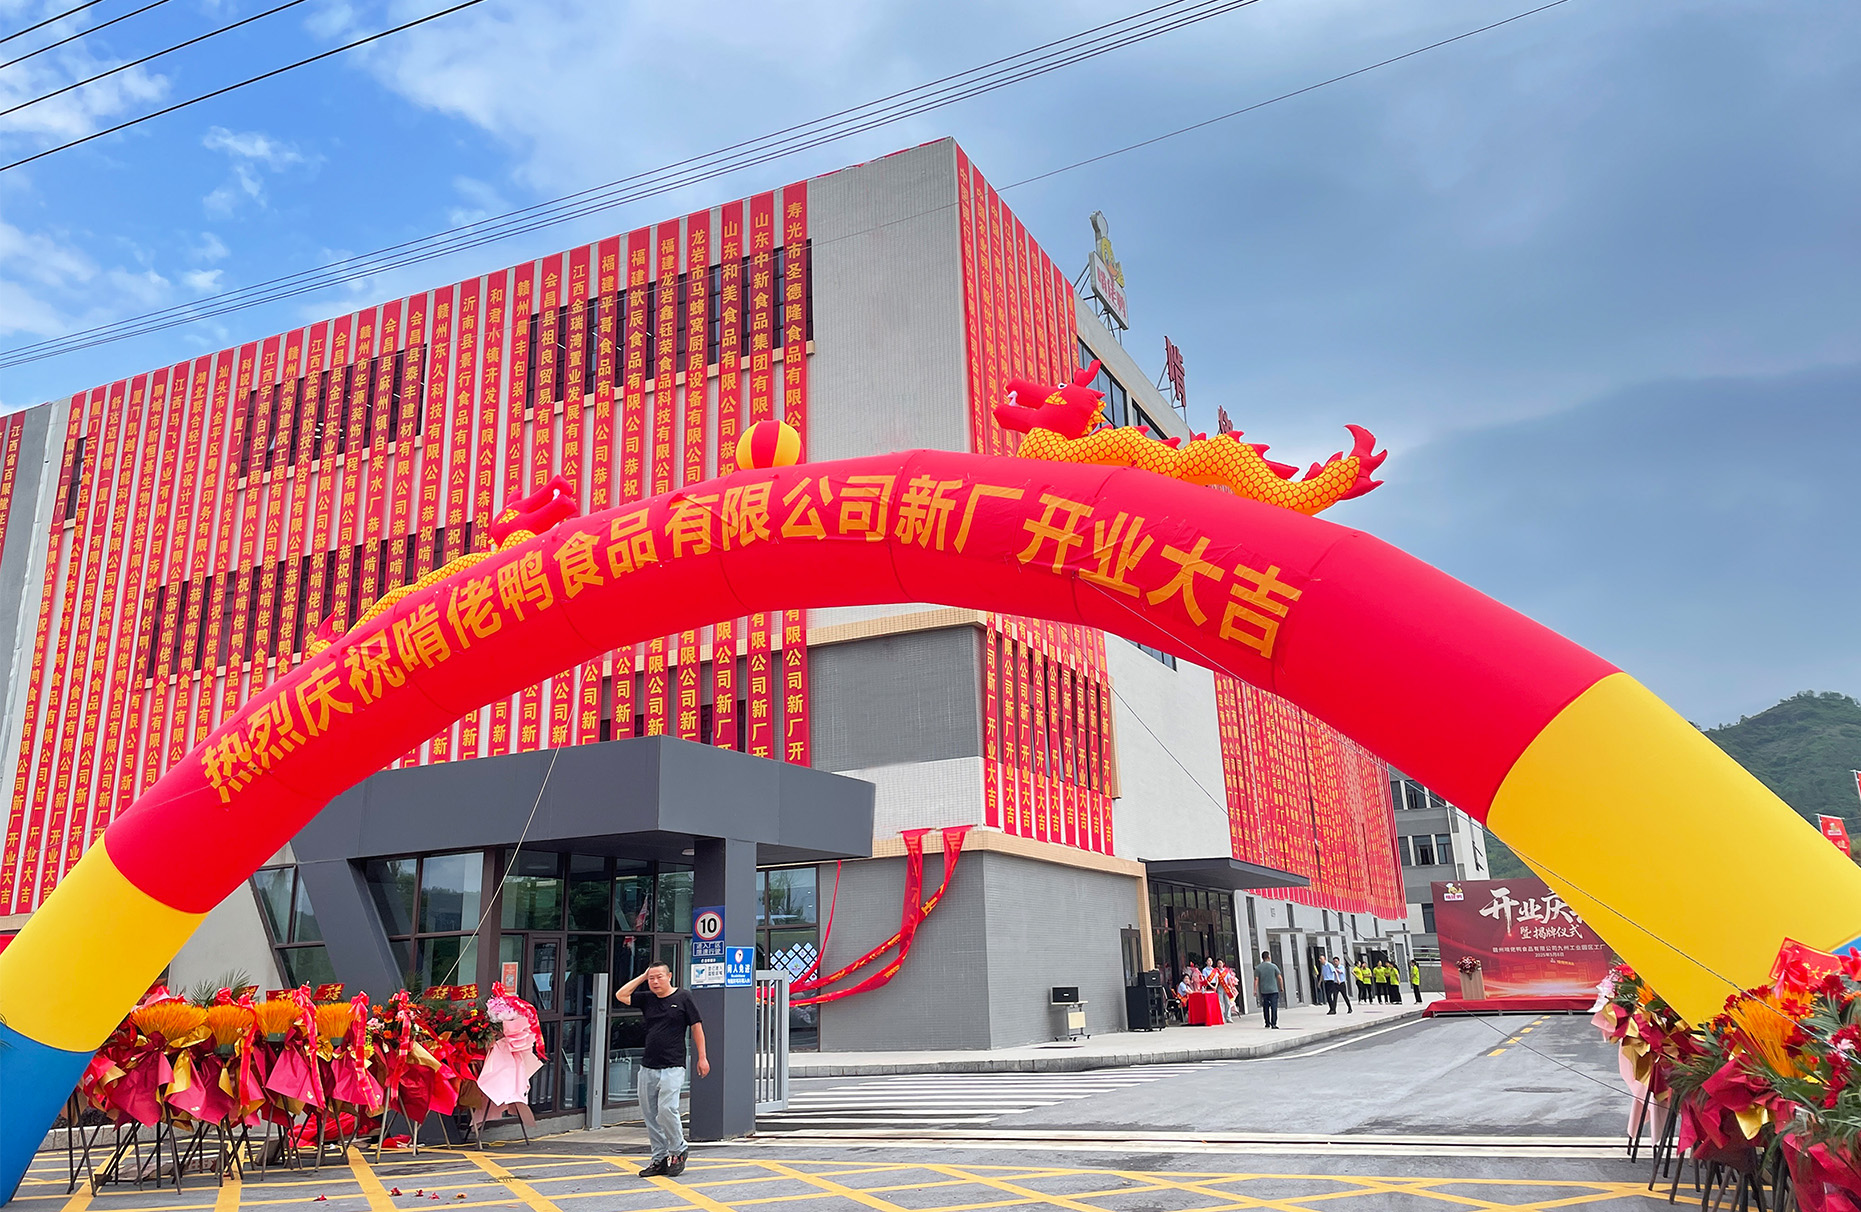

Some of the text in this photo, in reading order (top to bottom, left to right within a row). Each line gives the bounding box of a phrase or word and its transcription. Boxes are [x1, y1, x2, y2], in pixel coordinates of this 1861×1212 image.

[145, 372, 206, 790] 湖北联合轻工业设计工程有限公司恭祝啃佬鸭食品有限公司
[171, 366, 228, 760] 汕头市金平区粤盛印务有限公司恭祝啃佬鸭食品有限公
[200, 474, 1304, 804] 热烈庆祝啃佬鸭食品有限公司新厂开业大吉
[1002, 614, 1014, 825] 有限公司新厂开业大吉
[1019, 616, 1030, 828] 有限公司新厂开业大吉
[700, 918, 717, 933] 10
[1479, 887, 1583, 936] 开业庆
[1520, 924, 1583, 939] 暨揭牌仪式
